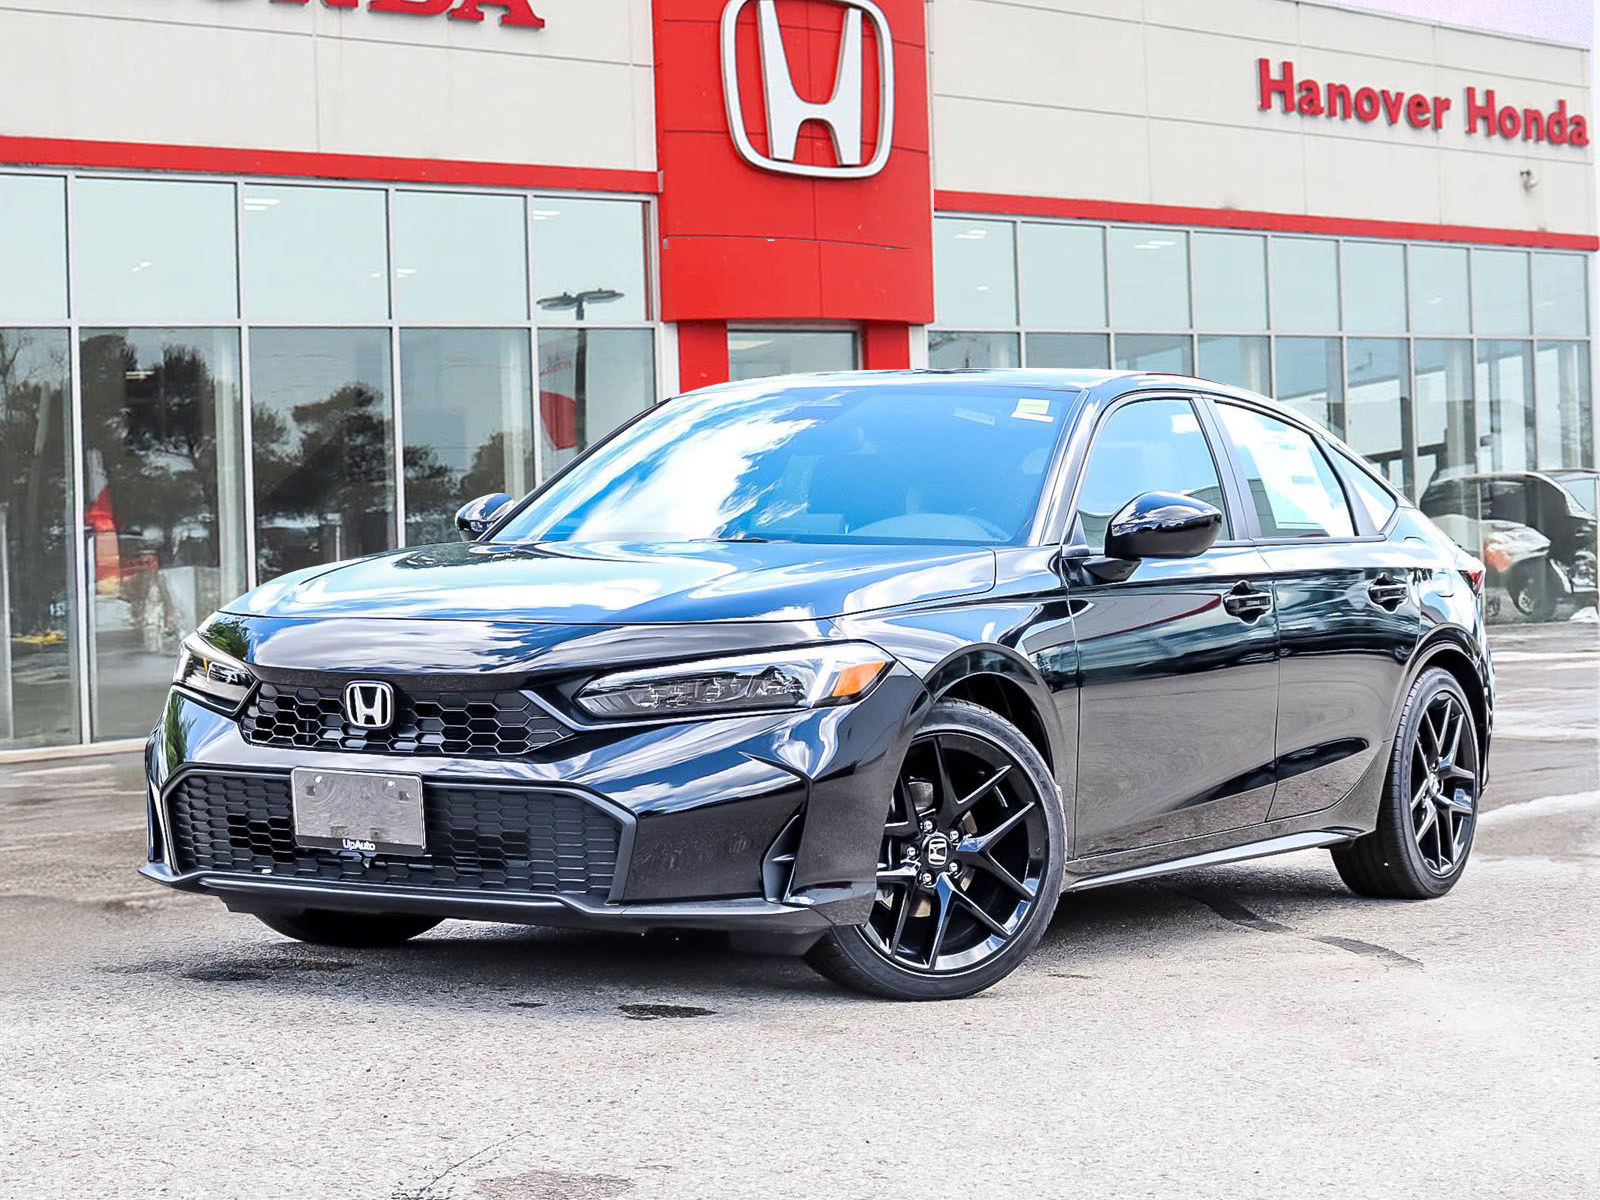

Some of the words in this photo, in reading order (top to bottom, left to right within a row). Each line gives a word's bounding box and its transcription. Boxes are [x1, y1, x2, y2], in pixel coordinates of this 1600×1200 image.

[1258, 58, 1451, 130] Hanover
[1466, 87, 1590, 146] Honda
[342, 838, 376, 851] UpAuto
